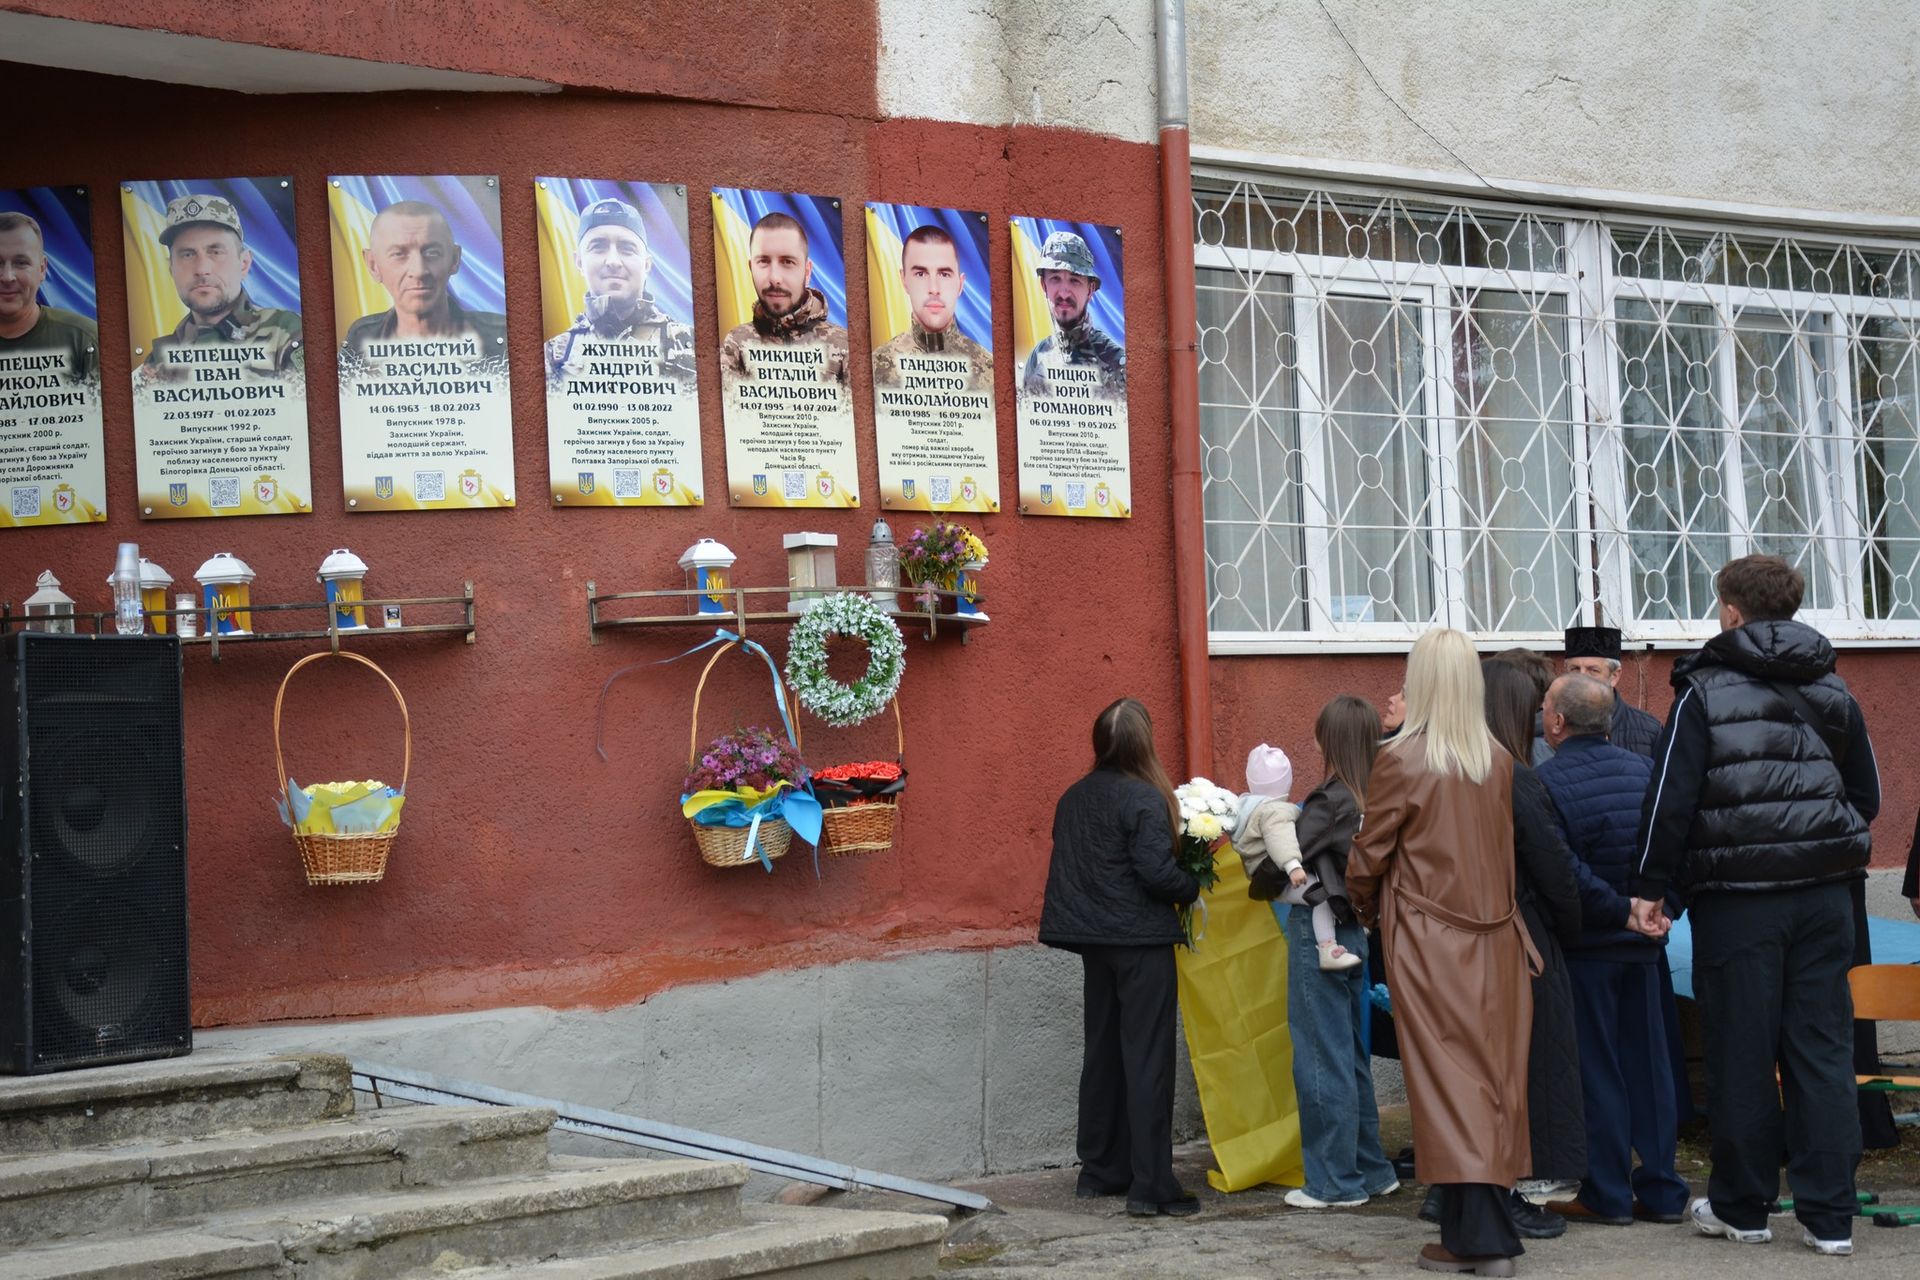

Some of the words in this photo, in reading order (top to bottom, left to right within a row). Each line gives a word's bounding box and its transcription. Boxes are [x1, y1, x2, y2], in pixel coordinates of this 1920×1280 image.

[369, 339, 476, 358] ШИБІСТИЙ
[582, 343, 658, 358] ЖУПНИК
[168, 347, 265, 363] КЕПЕЩУК
[749, 349, 823, 364] МИКИЦЕЙ
[385, 362, 461, 377] ВАСИЛЬ
[589, 360, 652, 378] АНДРІЙ
[900, 358, 967, 374] ГАНДЗЮК
[195, 367, 241, 381] ІВАН
[758, 366, 817, 382] ВІТАЛІЙ
[1047, 368, 1096, 383] ПИЦЮК
[357, 377, 492, 397] МИХАЙЛОВИЧ
[567, 381, 676, 396] ДМИТРОВИЧ
[905, 377, 963, 391] ДМИТРО
[153, 385, 285, 402] ВАСИЛЬОВИЧ
[740, 385, 837, 401] ВАСИЛЬОВИЧ
[1056, 385, 1089, 398] ЮРІЙ
[882, 392, 988, 408] МИКОЛАЙОВИЧ
[369, 404, 419, 414] 14.06.1963
[430, 402, 480, 412] 18.02.2023
[573, 402, 618, 411] 01.02.1990
[628, 402, 672, 412] 13.08.2022
[740, 402, 783, 411] 14.07.1995
[793, 403, 837, 412] 14.07.2024
[1033, 401, 1113, 417] РОМАНОВИЧ
[163, 410, 214, 420] 22.03.1977
[224, 408, 276, 418] 01.02.2023
[759, 412, 795, 421] Випускник
[890, 409, 930, 417] 28.10.1985
[939, 411, 981, 420] 16.09.2024
[29, 415, 83, 426] 17.08.2023
[387, 418, 433, 427] Випускник
[458, 418, 465, 426] р.
[588, 416, 629, 424] Випускник
[653, 417, 659, 426] р.
[1030, 419, 1070, 427] 06.02.1993
[1078, 421, 1116, 430] 19.05.2025
[55, 430, 62, 439] р.
[181, 424, 228, 434] Випускник
[253, 424, 260, 432] р.
[390, 430, 428, 439] Захисник
[761, 430, 792, 438] молодший
[149, 438, 188, 447] Захисник
[227, 435, 261, 444] старший
[388, 439, 429, 448] молодший
[564, 438, 595, 446] героїчно
[626, 439, 630, 447] у
[632, 438, 647, 446] бою
[658, 439, 684, 447] Україну
[28, 443, 61, 453] старший
[153, 447, 188, 457] героїчно
[190, 446, 221, 455] загинув
[224, 446, 228, 454] у
[259, 444, 290, 453] Україну
[367, 451, 393, 459] віддав
[454, 448, 488, 456] України.
[576, 448, 605, 456] поблизу
[650, 449, 673, 457] пункту
[26, 454, 30, 462] у
[32, 453, 47, 461] бою
[59, 451, 87, 460] Україну
[167, 456, 200, 466] поблизу
[202, 456, 248, 464] населеного
[250, 455, 278, 463] пункту
[572, 457, 606, 465] Полтавка
[608, 457, 650, 466] Запорізької
[651, 457, 679, 465] області.
[26, 463, 73, 473] Дорожнянка
[160, 467, 207, 476] Білогорівка
[209, 465, 251, 475] Донецької
[254, 463, 285, 472] області.
[33, 473, 62, 481] області.
